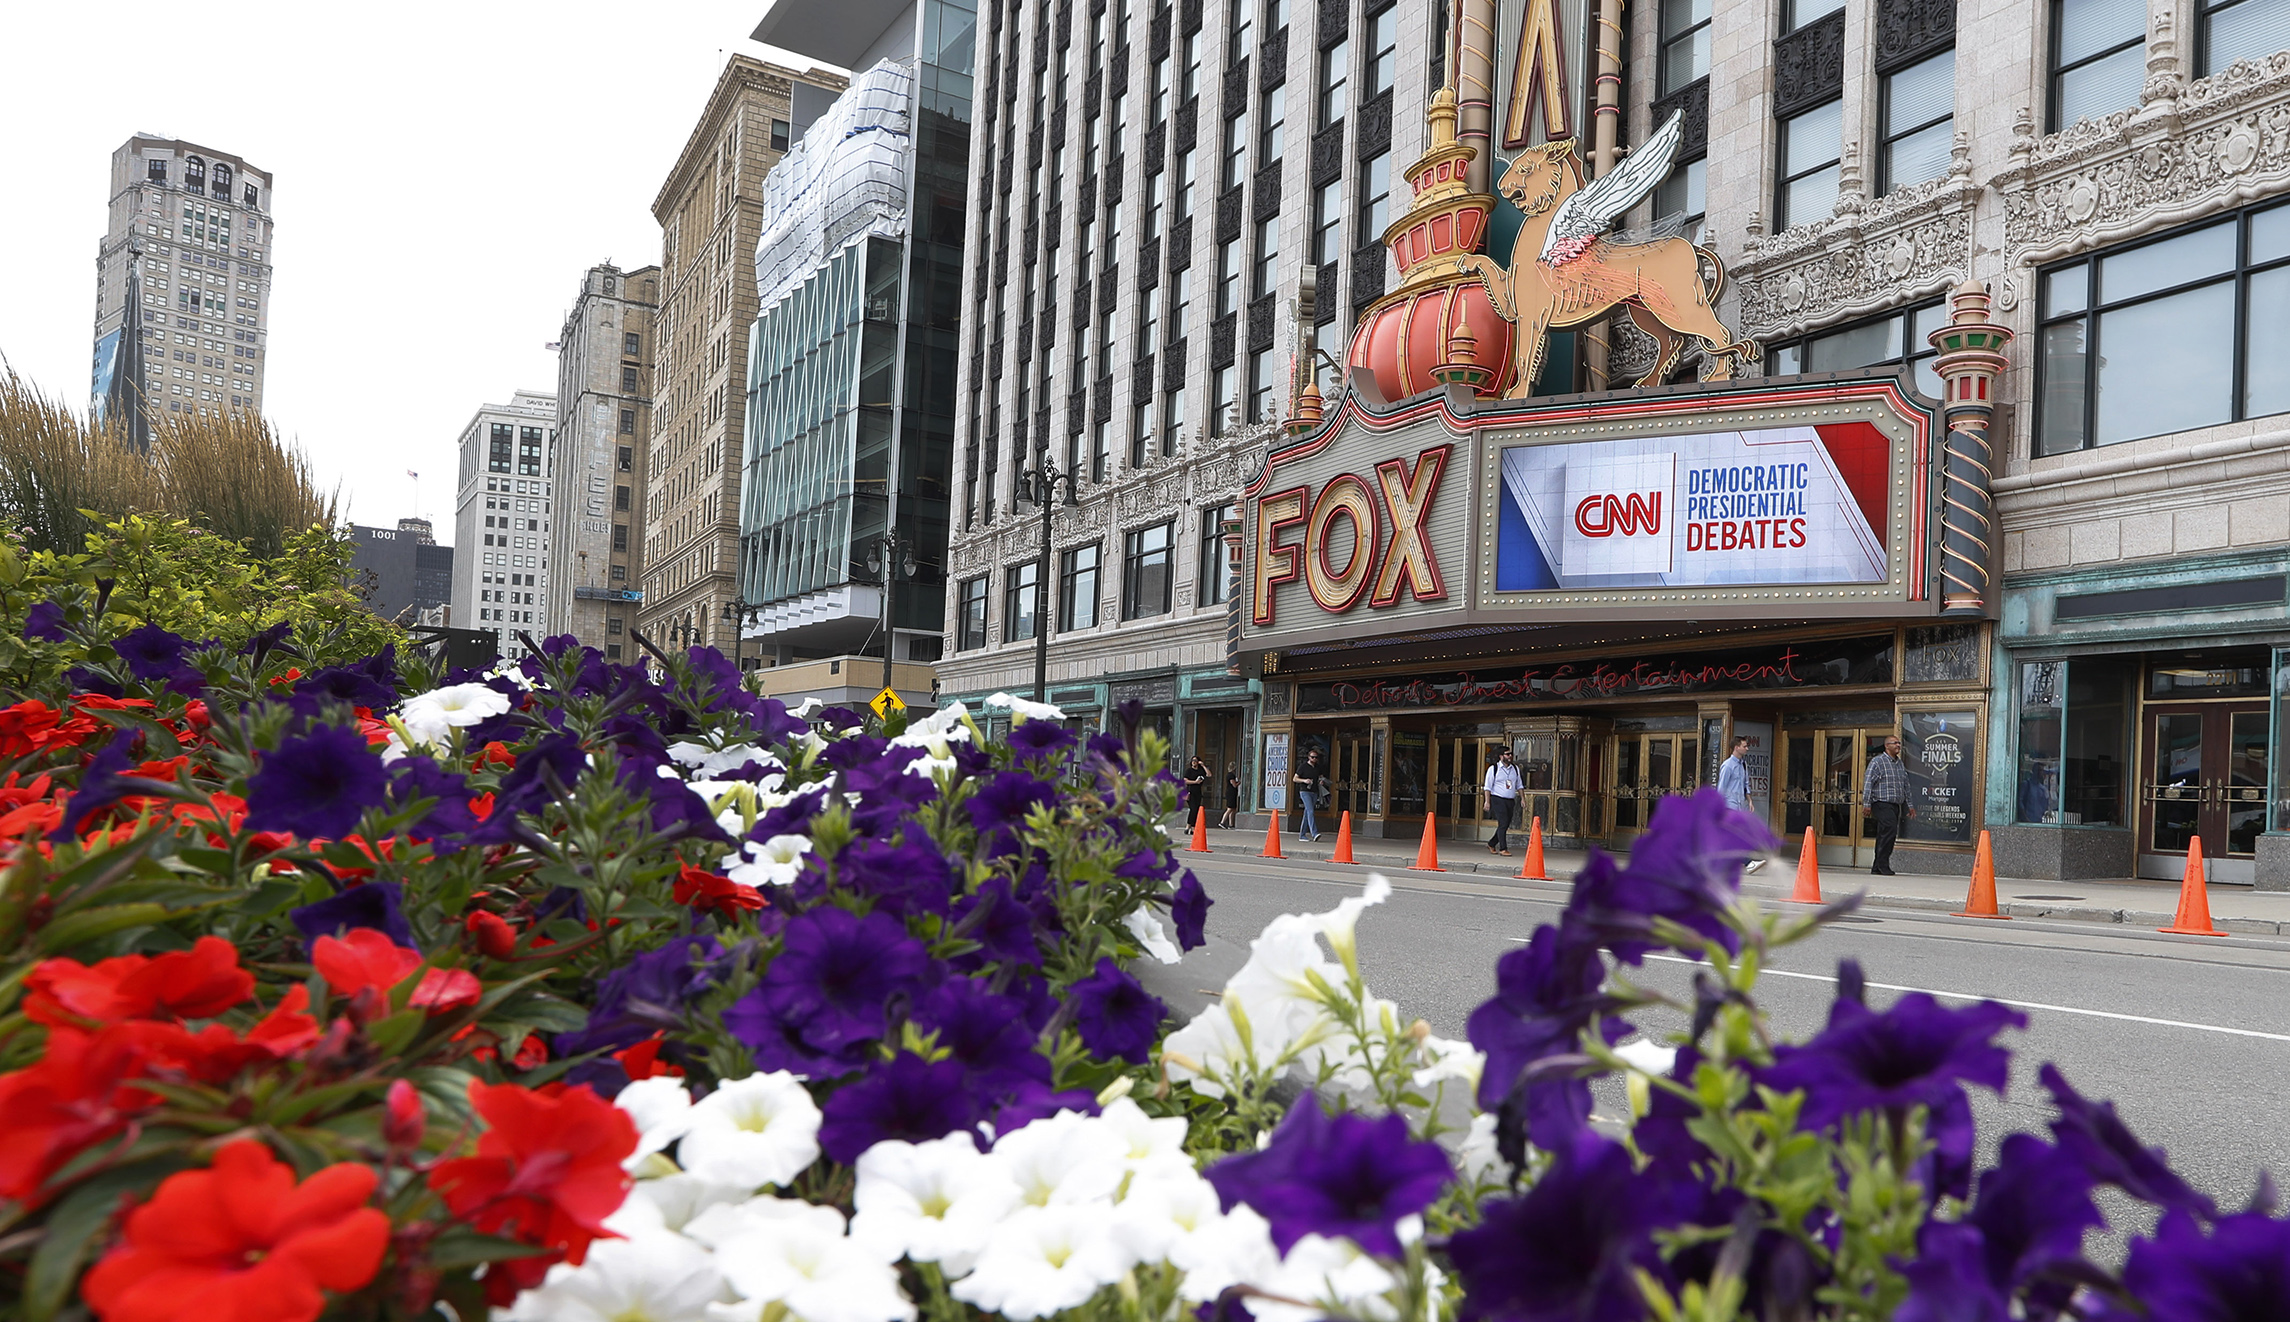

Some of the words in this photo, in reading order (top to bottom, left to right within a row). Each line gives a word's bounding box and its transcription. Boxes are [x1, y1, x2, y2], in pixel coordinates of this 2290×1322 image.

[1689, 463, 1808, 495] DEMOCRATIC
[1688, 491, 1807, 520] PRESIDENTIAL
[1575, 491, 1662, 538] CNN
[371, 530, 396, 540] 1001
[1253, 444, 1454, 625] FOX
[1687, 518, 1807, 552] DEBATES
[1924, 642, 1960, 664] FOX
[1332, 679, 1437, 707] Detroit's
[1550, 647, 1803, 694] Entertainment
[2206, 671, 2237, 686] 2211
[1925, 743, 1958, 751] SUMMER
[1268, 756, 1288, 771] CHOICE
[1921, 750, 1962, 764] FINALS
[1267, 770, 1287, 787] 2020
[1748, 777, 1769, 791] ATES
[1922, 787, 1957, 796] ROCKET
[1941, 805, 1961, 813] LEGENDS
[1945, 812, 1967, 820] WEEKEND
